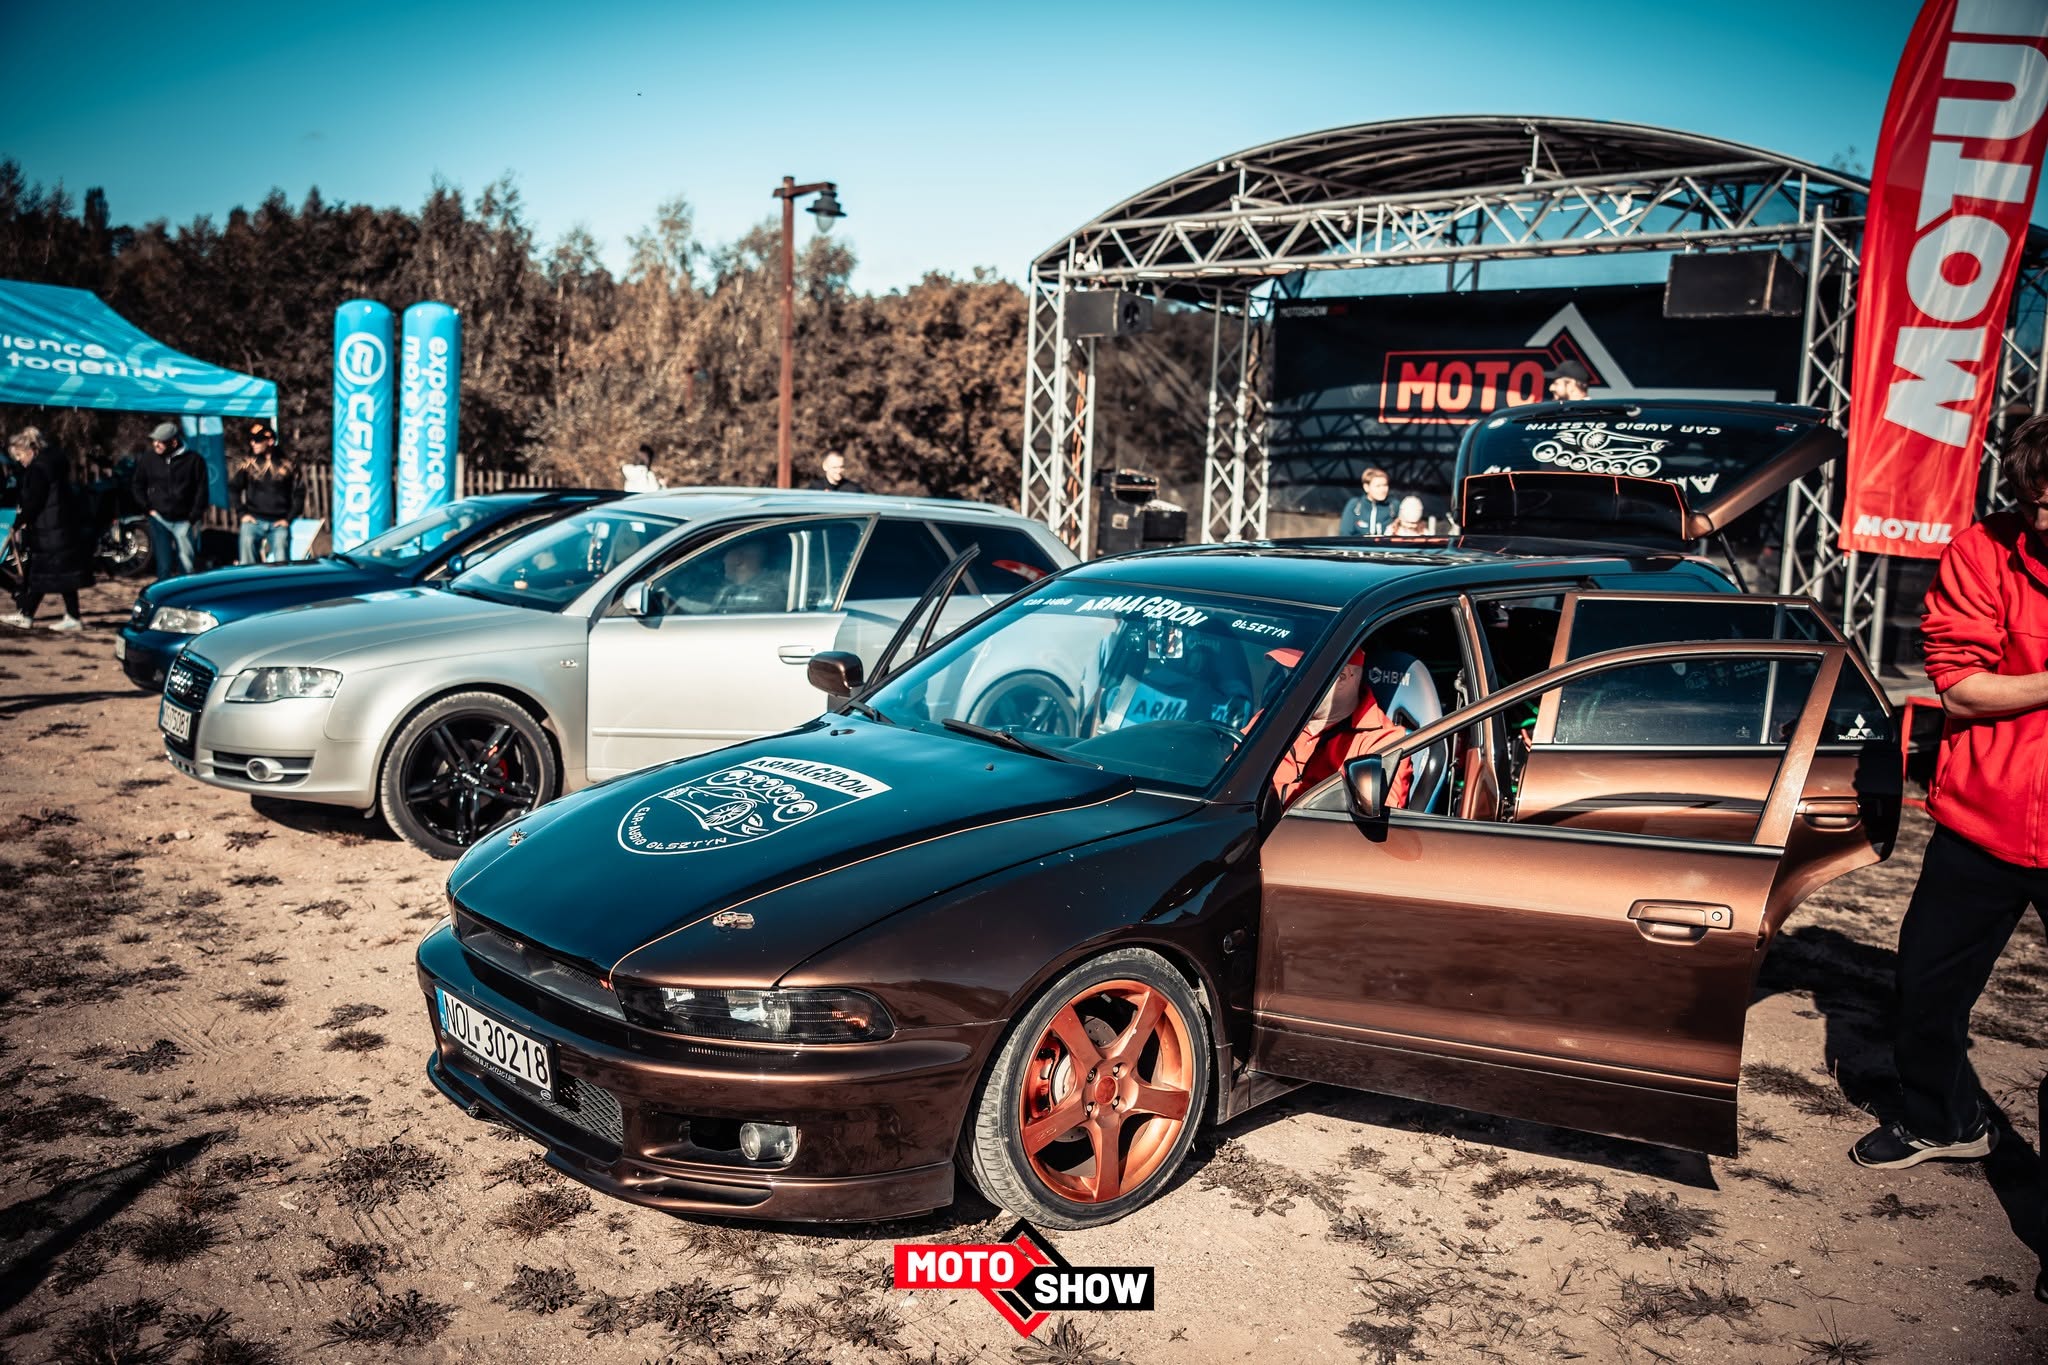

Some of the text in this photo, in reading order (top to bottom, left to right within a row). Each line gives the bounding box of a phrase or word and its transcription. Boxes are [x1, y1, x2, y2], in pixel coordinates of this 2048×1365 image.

[0, 333, 107, 359] ience
[1397, 361, 1545, 413] MOTO
[421, 336, 448, 490] experience
[1853, 514, 1953, 544] MOTUL
[1075, 596, 1208, 627] ARMAGEDON
[748, 760, 872, 793] ARMAGEDON
[444, 995, 477, 1049] NOL
[483, 1019, 549, 1085] 30218
